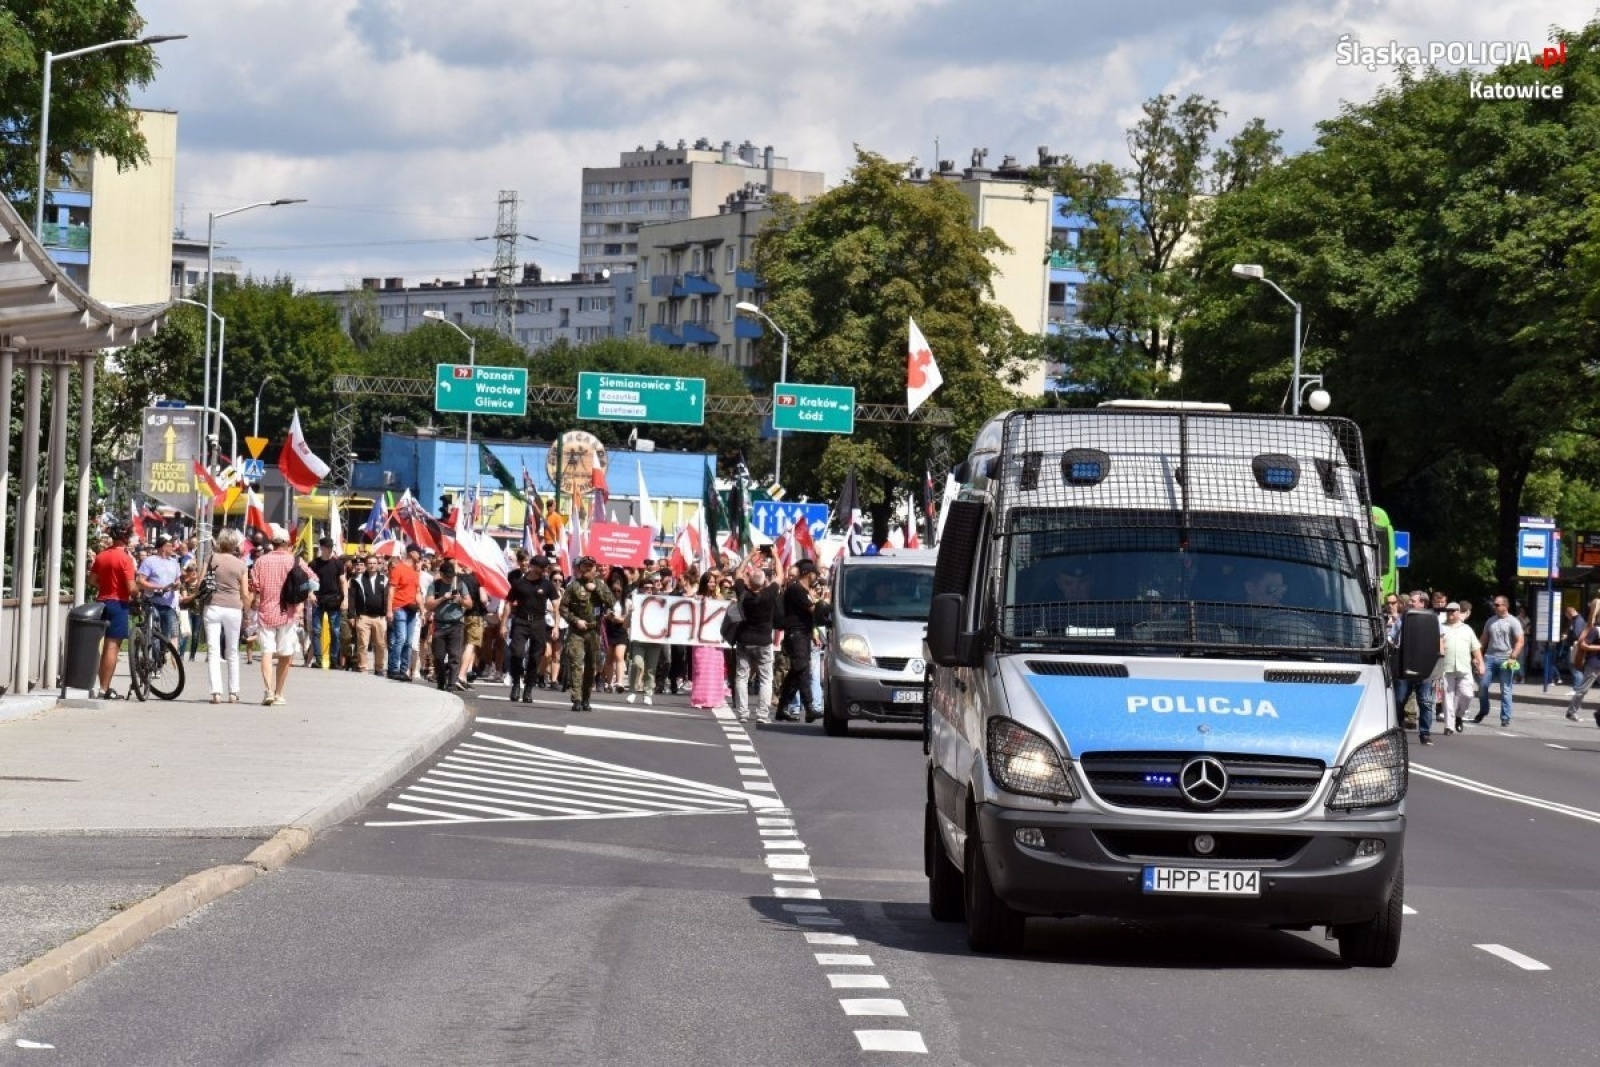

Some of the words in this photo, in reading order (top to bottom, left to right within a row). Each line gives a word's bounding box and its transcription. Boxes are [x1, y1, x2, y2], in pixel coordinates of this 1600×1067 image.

[459, 369, 468, 377] 79
[476, 369, 514, 380] Poznań
[476, 382, 521, 395] Wrocław
[600, 377, 671, 390] Siemianowice
[675, 380, 688, 391] Śl.
[475, 397, 514, 408] Gliwice
[782, 396, 792, 405] 79
[800, 396, 838, 408] Kraków
[798, 410, 824, 421] Łódź
[152, 463, 186, 472] JESZCZE
[150, 480, 175, 492] 700
[177, 482, 190, 493] m
[1127, 696, 1279, 718] POLICJA
[1157, 869, 1200, 889] HPP
[1208, 871, 1256, 891] E104
